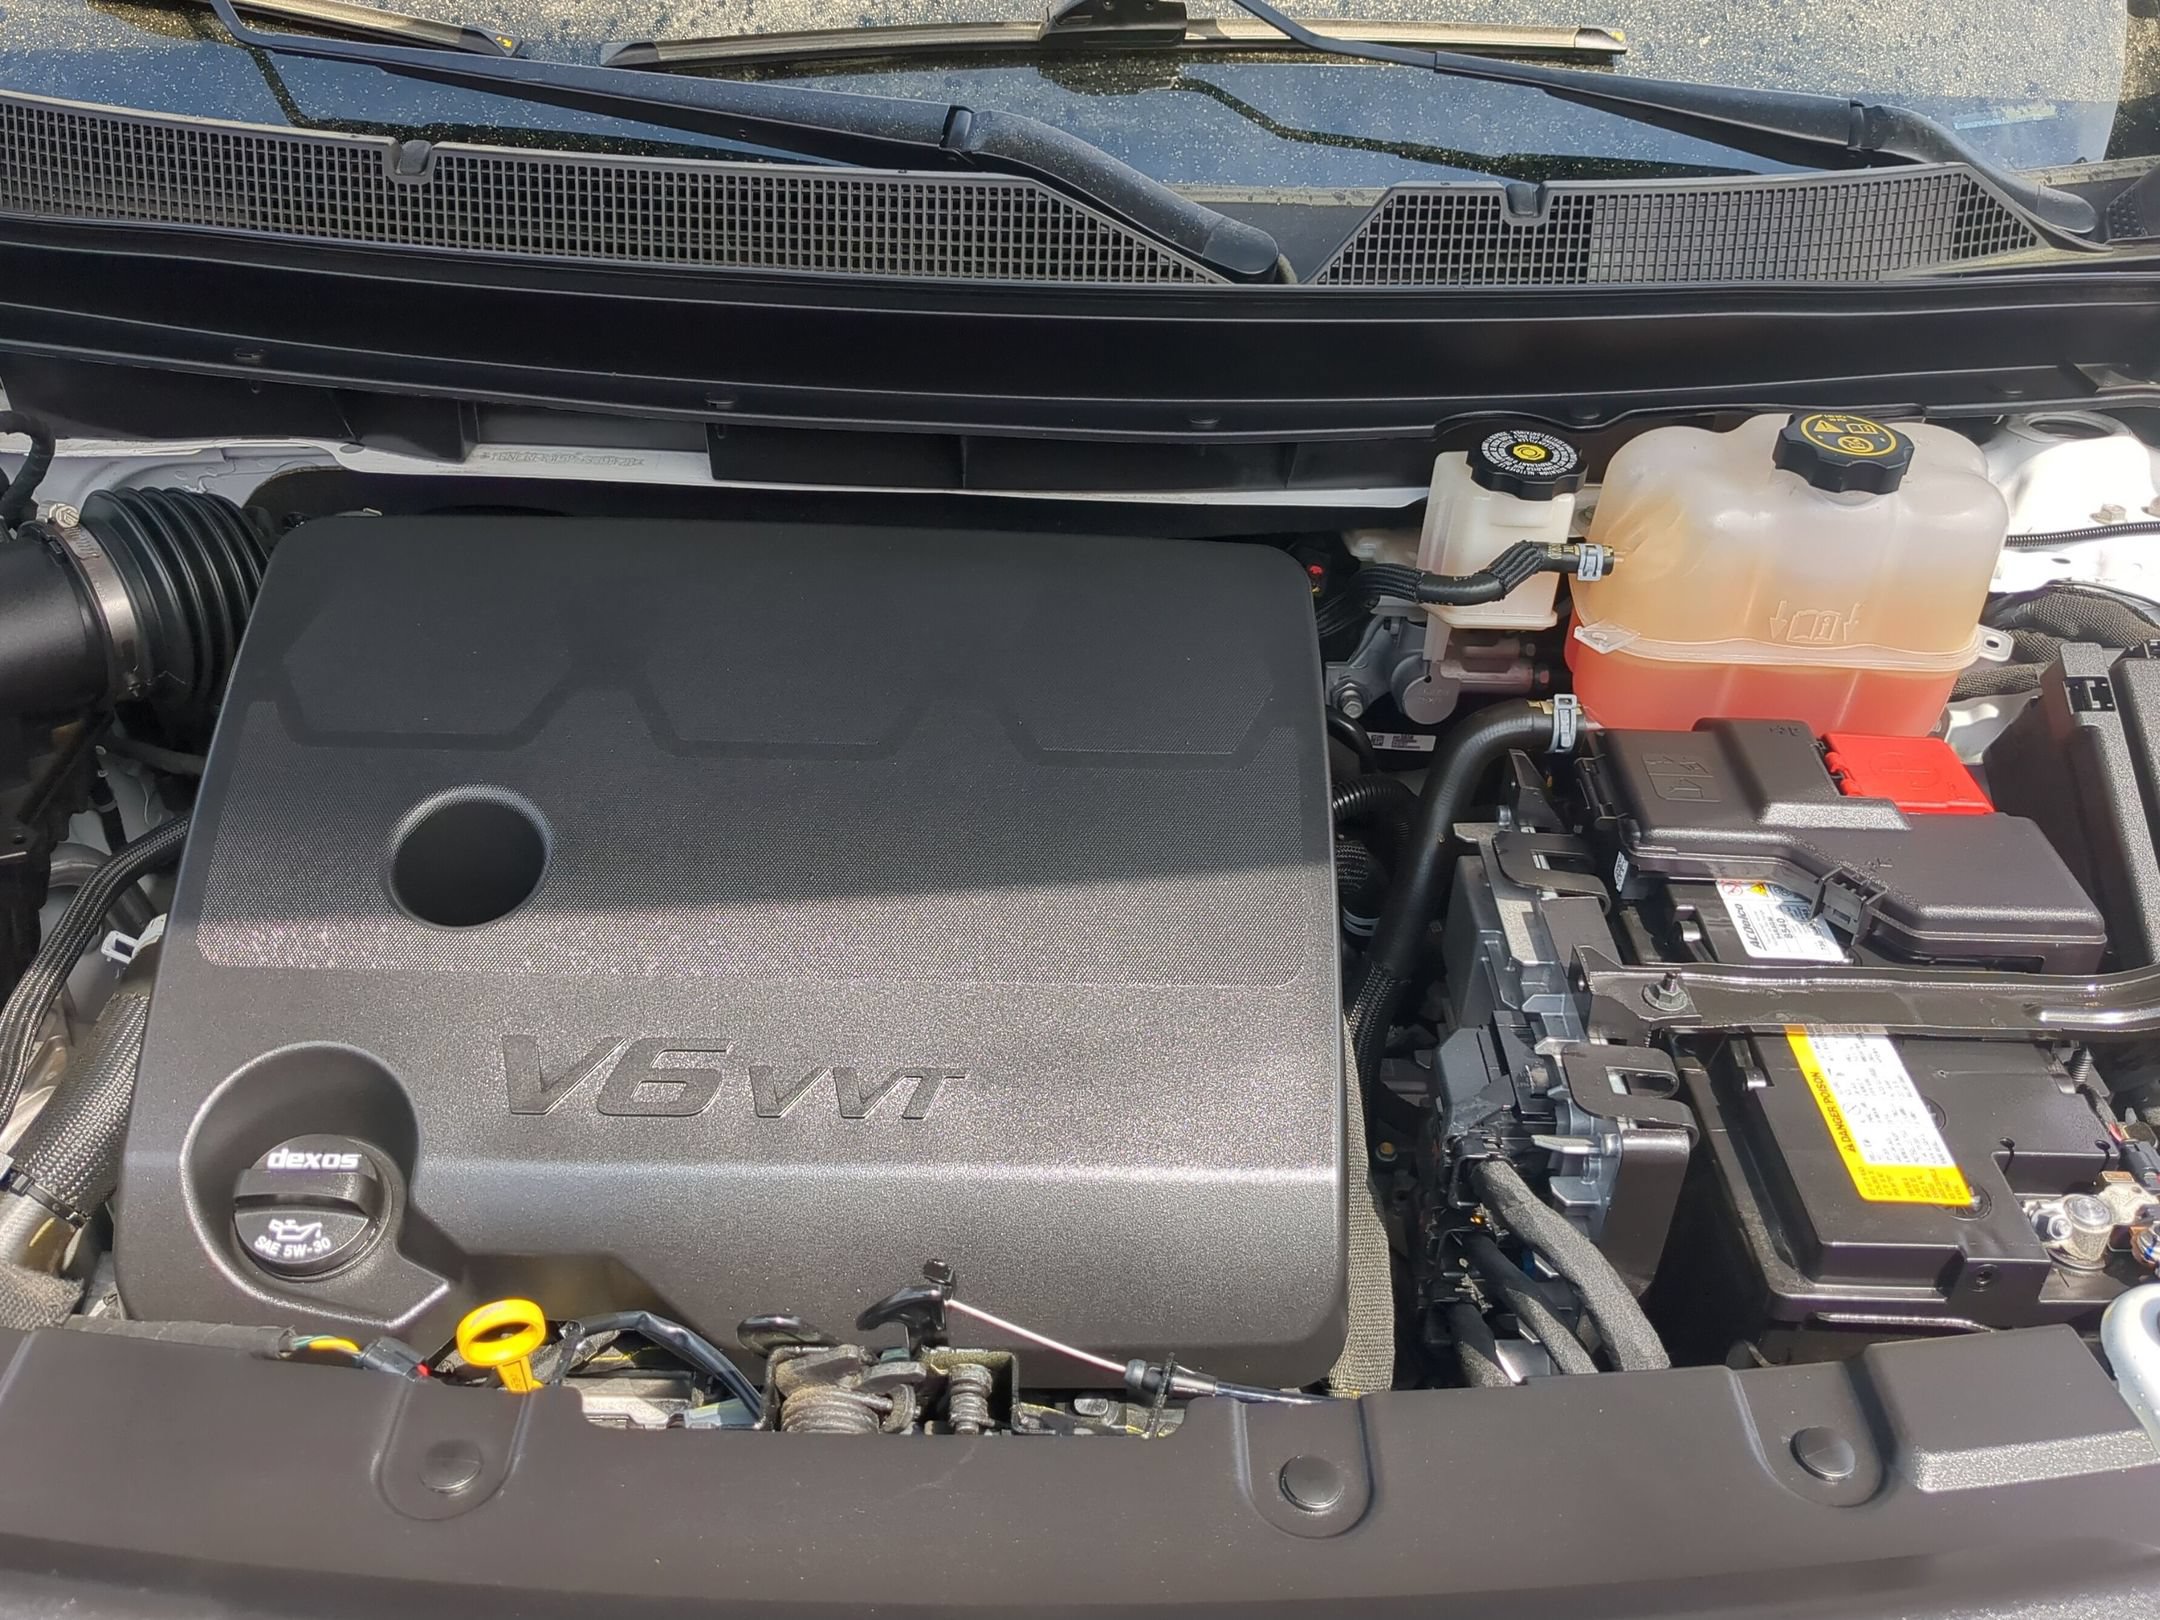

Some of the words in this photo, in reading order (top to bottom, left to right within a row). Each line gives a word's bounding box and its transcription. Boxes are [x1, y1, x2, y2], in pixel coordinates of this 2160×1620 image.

[1734, 903, 1763, 950] ACDelco
[1776, 917, 1794, 940] 8540
[502, 1034, 733, 1116] V6
[748, 1065, 969, 1120] VVT
[267, 1148, 362, 1170] dexos
[254, 1235, 281, 1256] SAE
[283, 1237, 332, 1259] 5W-30
